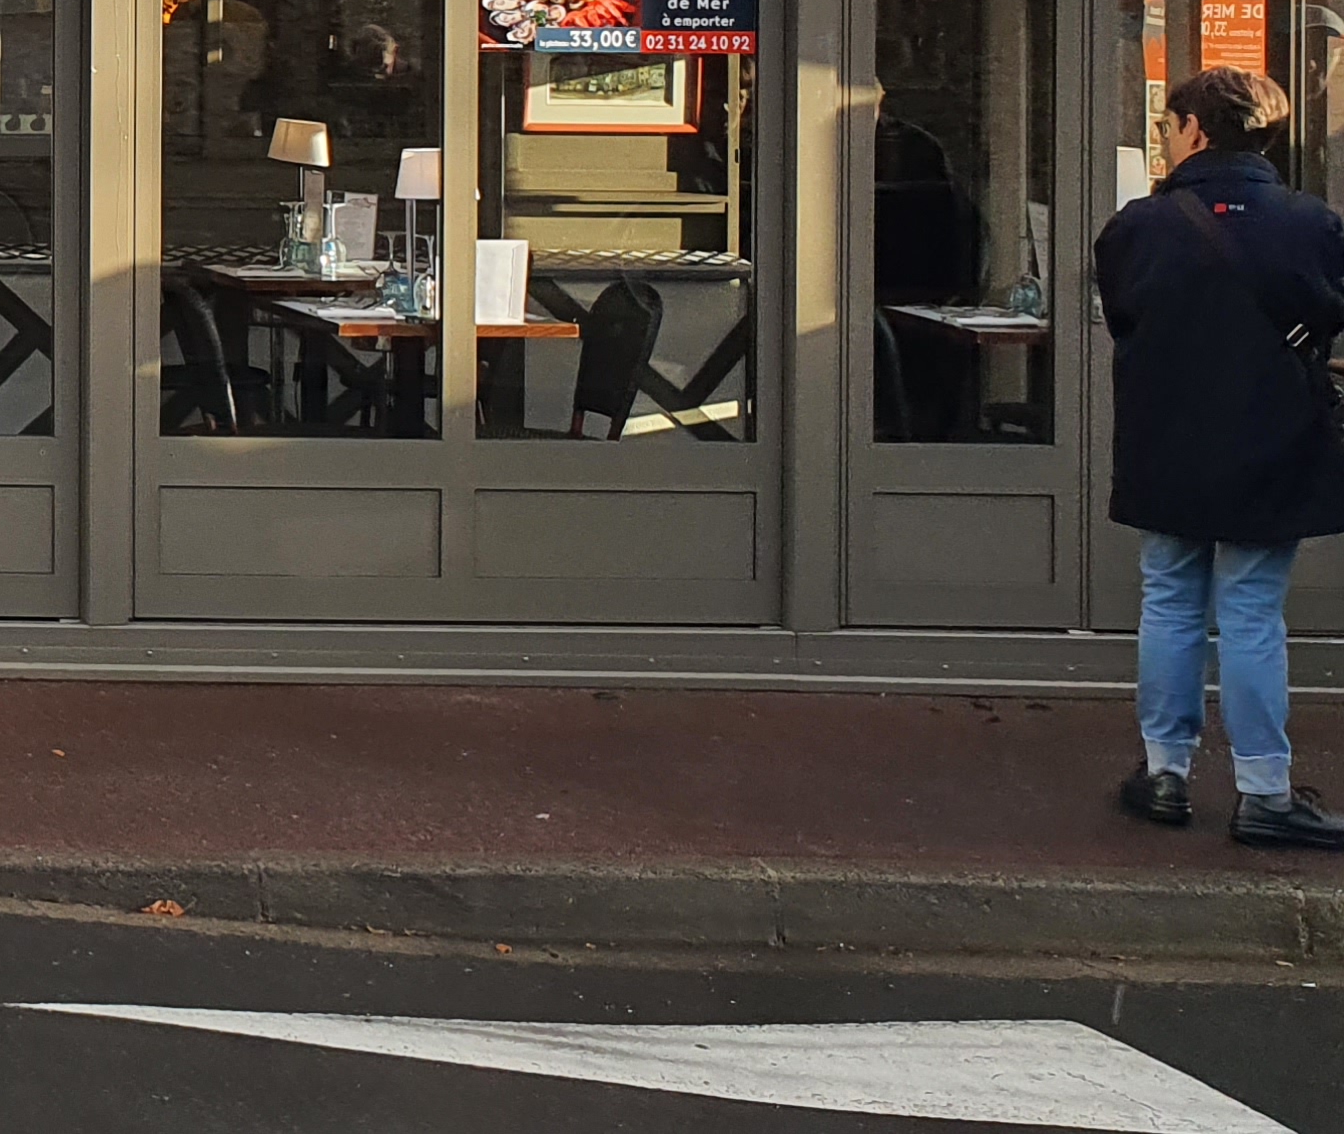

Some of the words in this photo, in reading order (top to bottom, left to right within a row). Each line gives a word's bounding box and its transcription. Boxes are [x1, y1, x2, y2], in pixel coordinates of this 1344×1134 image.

[661, 13, 671, 26] à
[674, 15, 735, 29] emporter
[646, 34, 664, 49] 02
[668, 35, 684, 50] 31
[689, 35, 707, 50] 24
[711, 35, 729, 50] 10
[732, 36, 750, 51] 92
